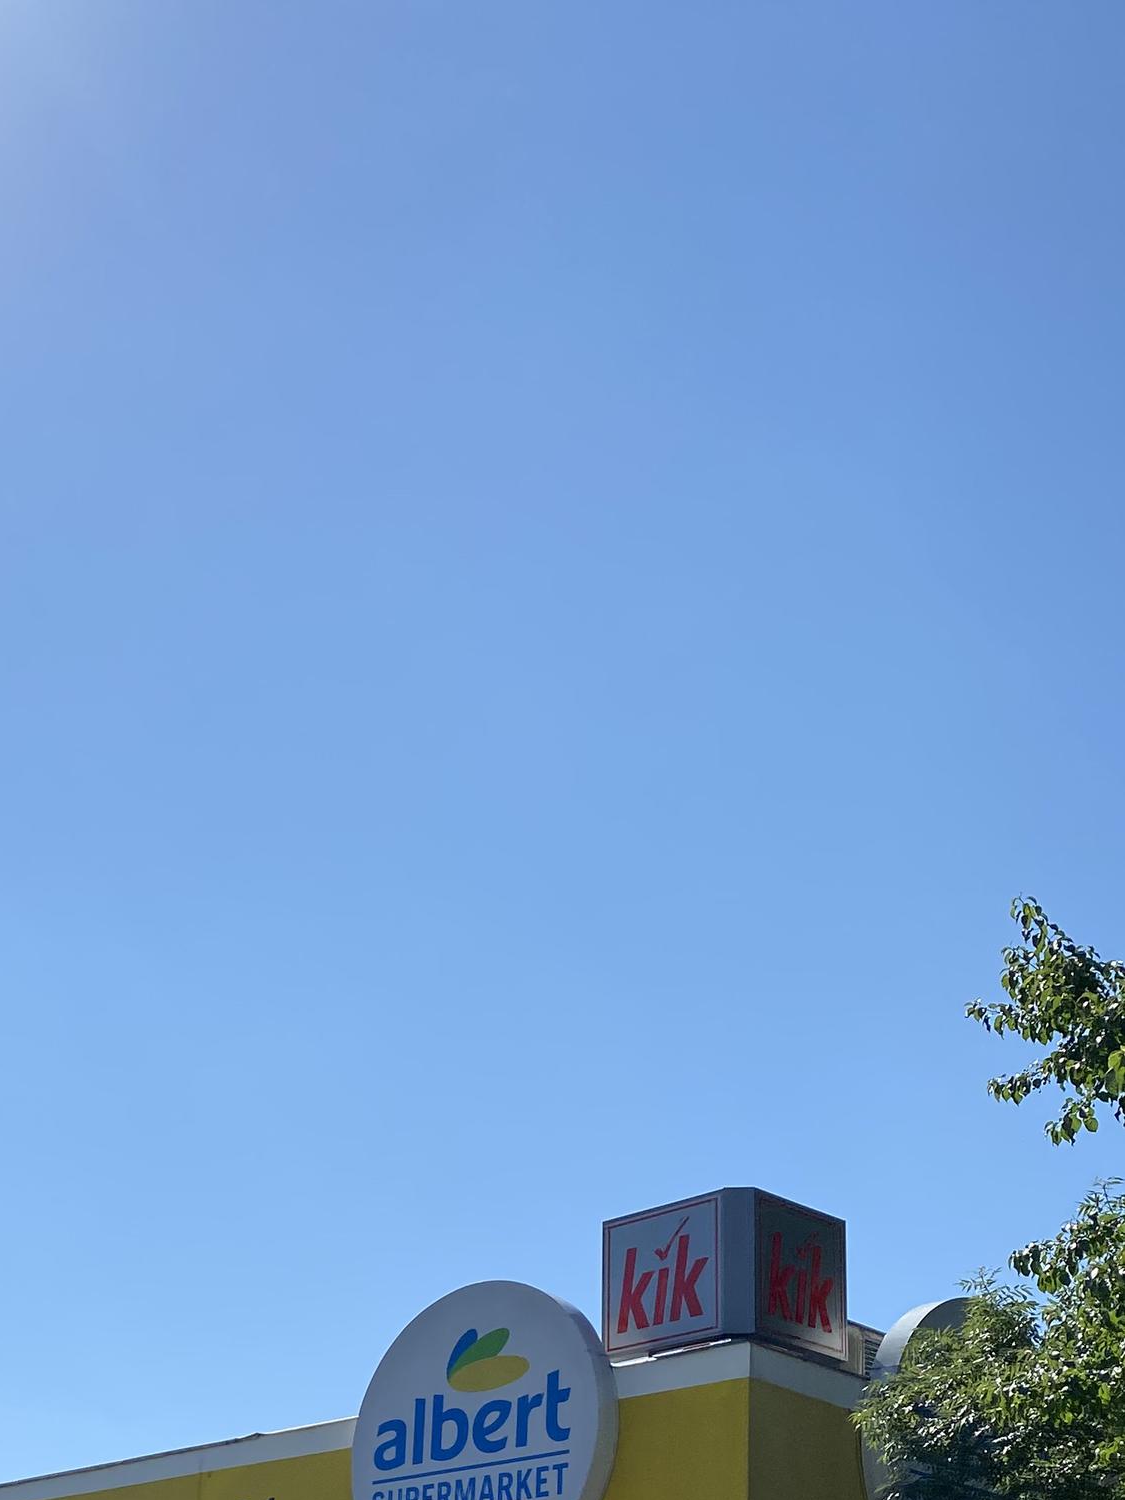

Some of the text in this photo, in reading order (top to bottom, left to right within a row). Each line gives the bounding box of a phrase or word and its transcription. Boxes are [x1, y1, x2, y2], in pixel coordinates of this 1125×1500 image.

[616, 1216, 709, 1334] kik
[767, 1231, 833, 1333] kik
[373, 1369, 572, 1471] albert
